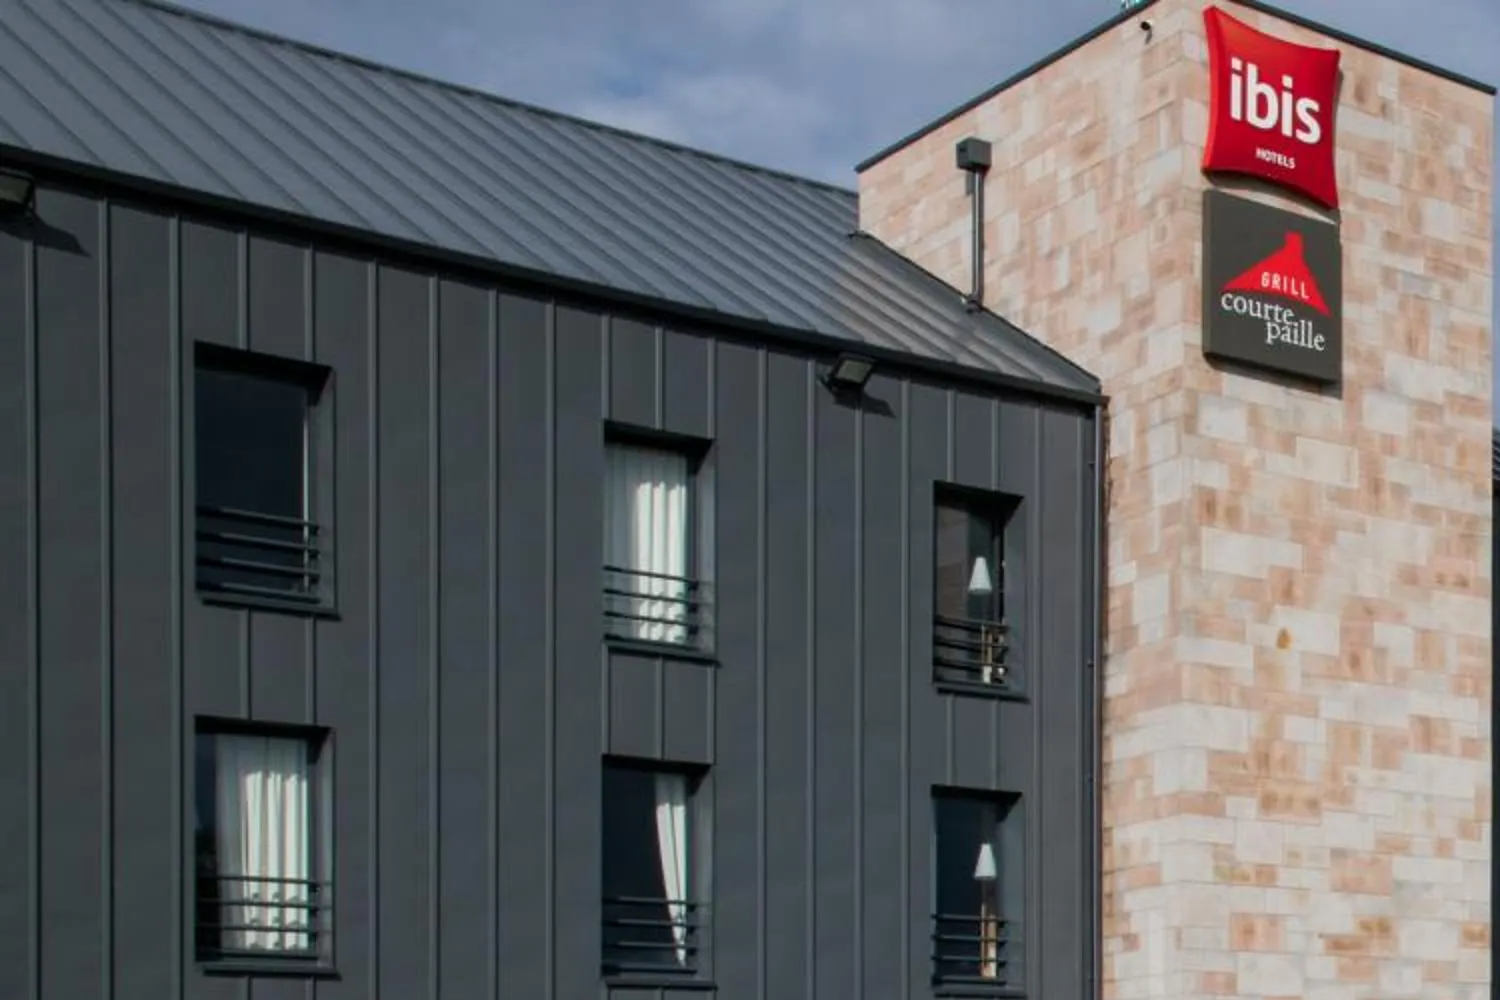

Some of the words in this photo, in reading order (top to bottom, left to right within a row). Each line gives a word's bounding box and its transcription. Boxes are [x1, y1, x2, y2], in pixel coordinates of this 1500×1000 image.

[1230, 57, 1321, 144] ibis
[1255, 147, 1296, 169] HOTELS
[1261, 271, 1310, 300] GRILL
[1221, 293, 1295, 326] courte
[1265, 319, 1325, 351] paille
